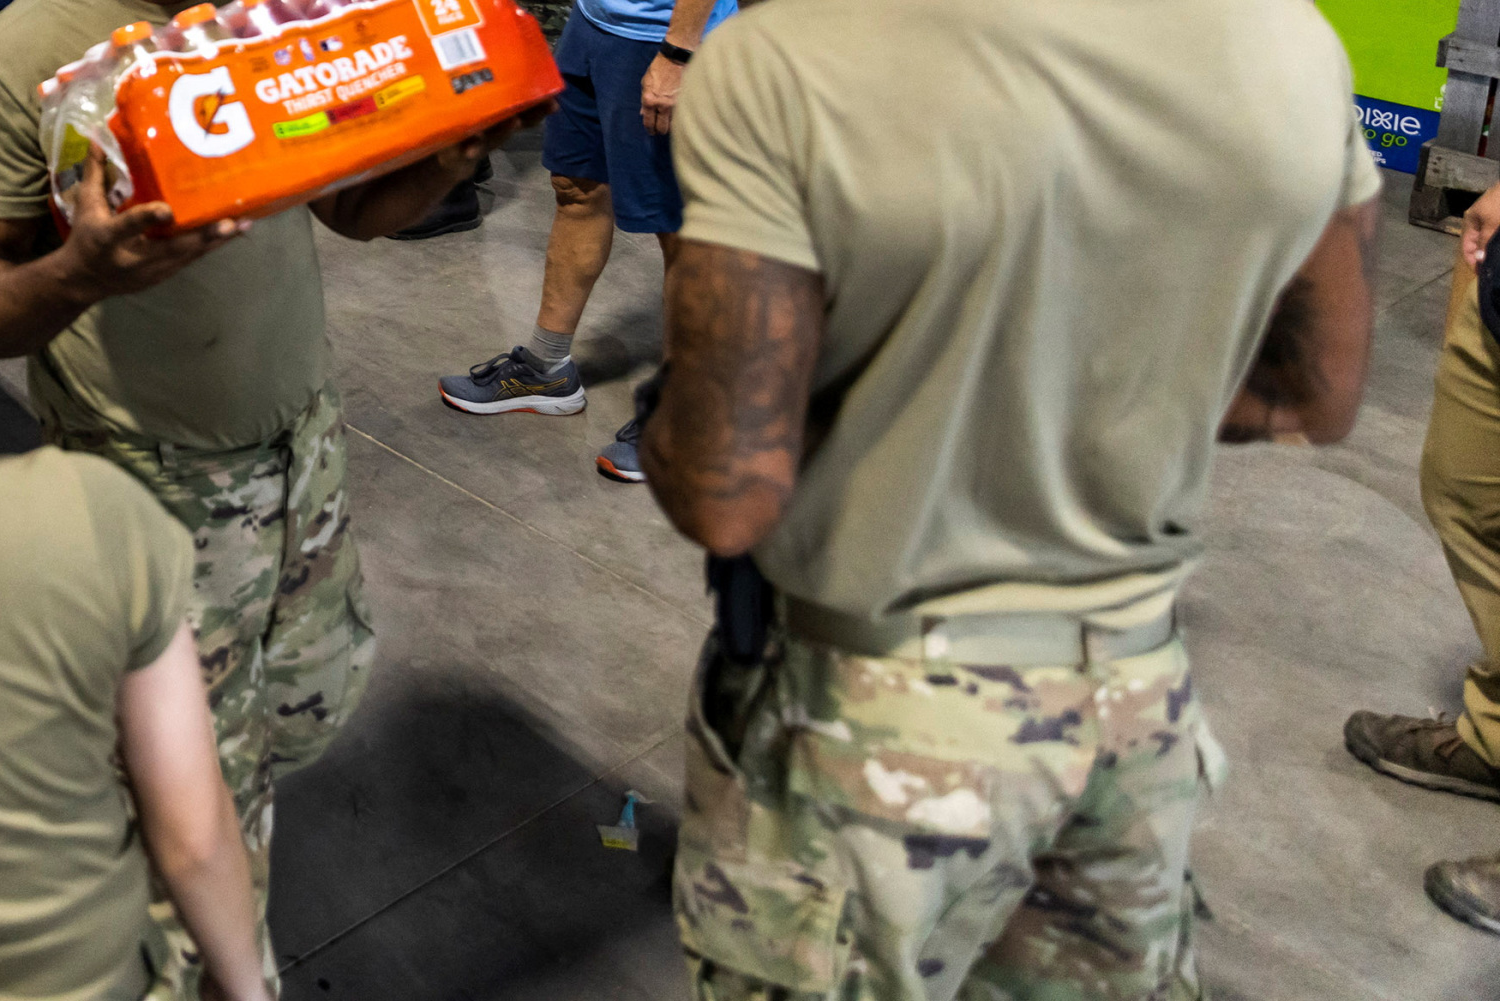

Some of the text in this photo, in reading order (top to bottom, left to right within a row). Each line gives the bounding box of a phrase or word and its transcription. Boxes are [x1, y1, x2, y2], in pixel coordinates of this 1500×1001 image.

[255, 35, 414, 104] GATORADE
[282, 87, 334, 116] THIRST
[335, 61, 408, 103] QUENCHER
[168, 65, 256, 158] G
[1380, 132, 1408, 148] go
